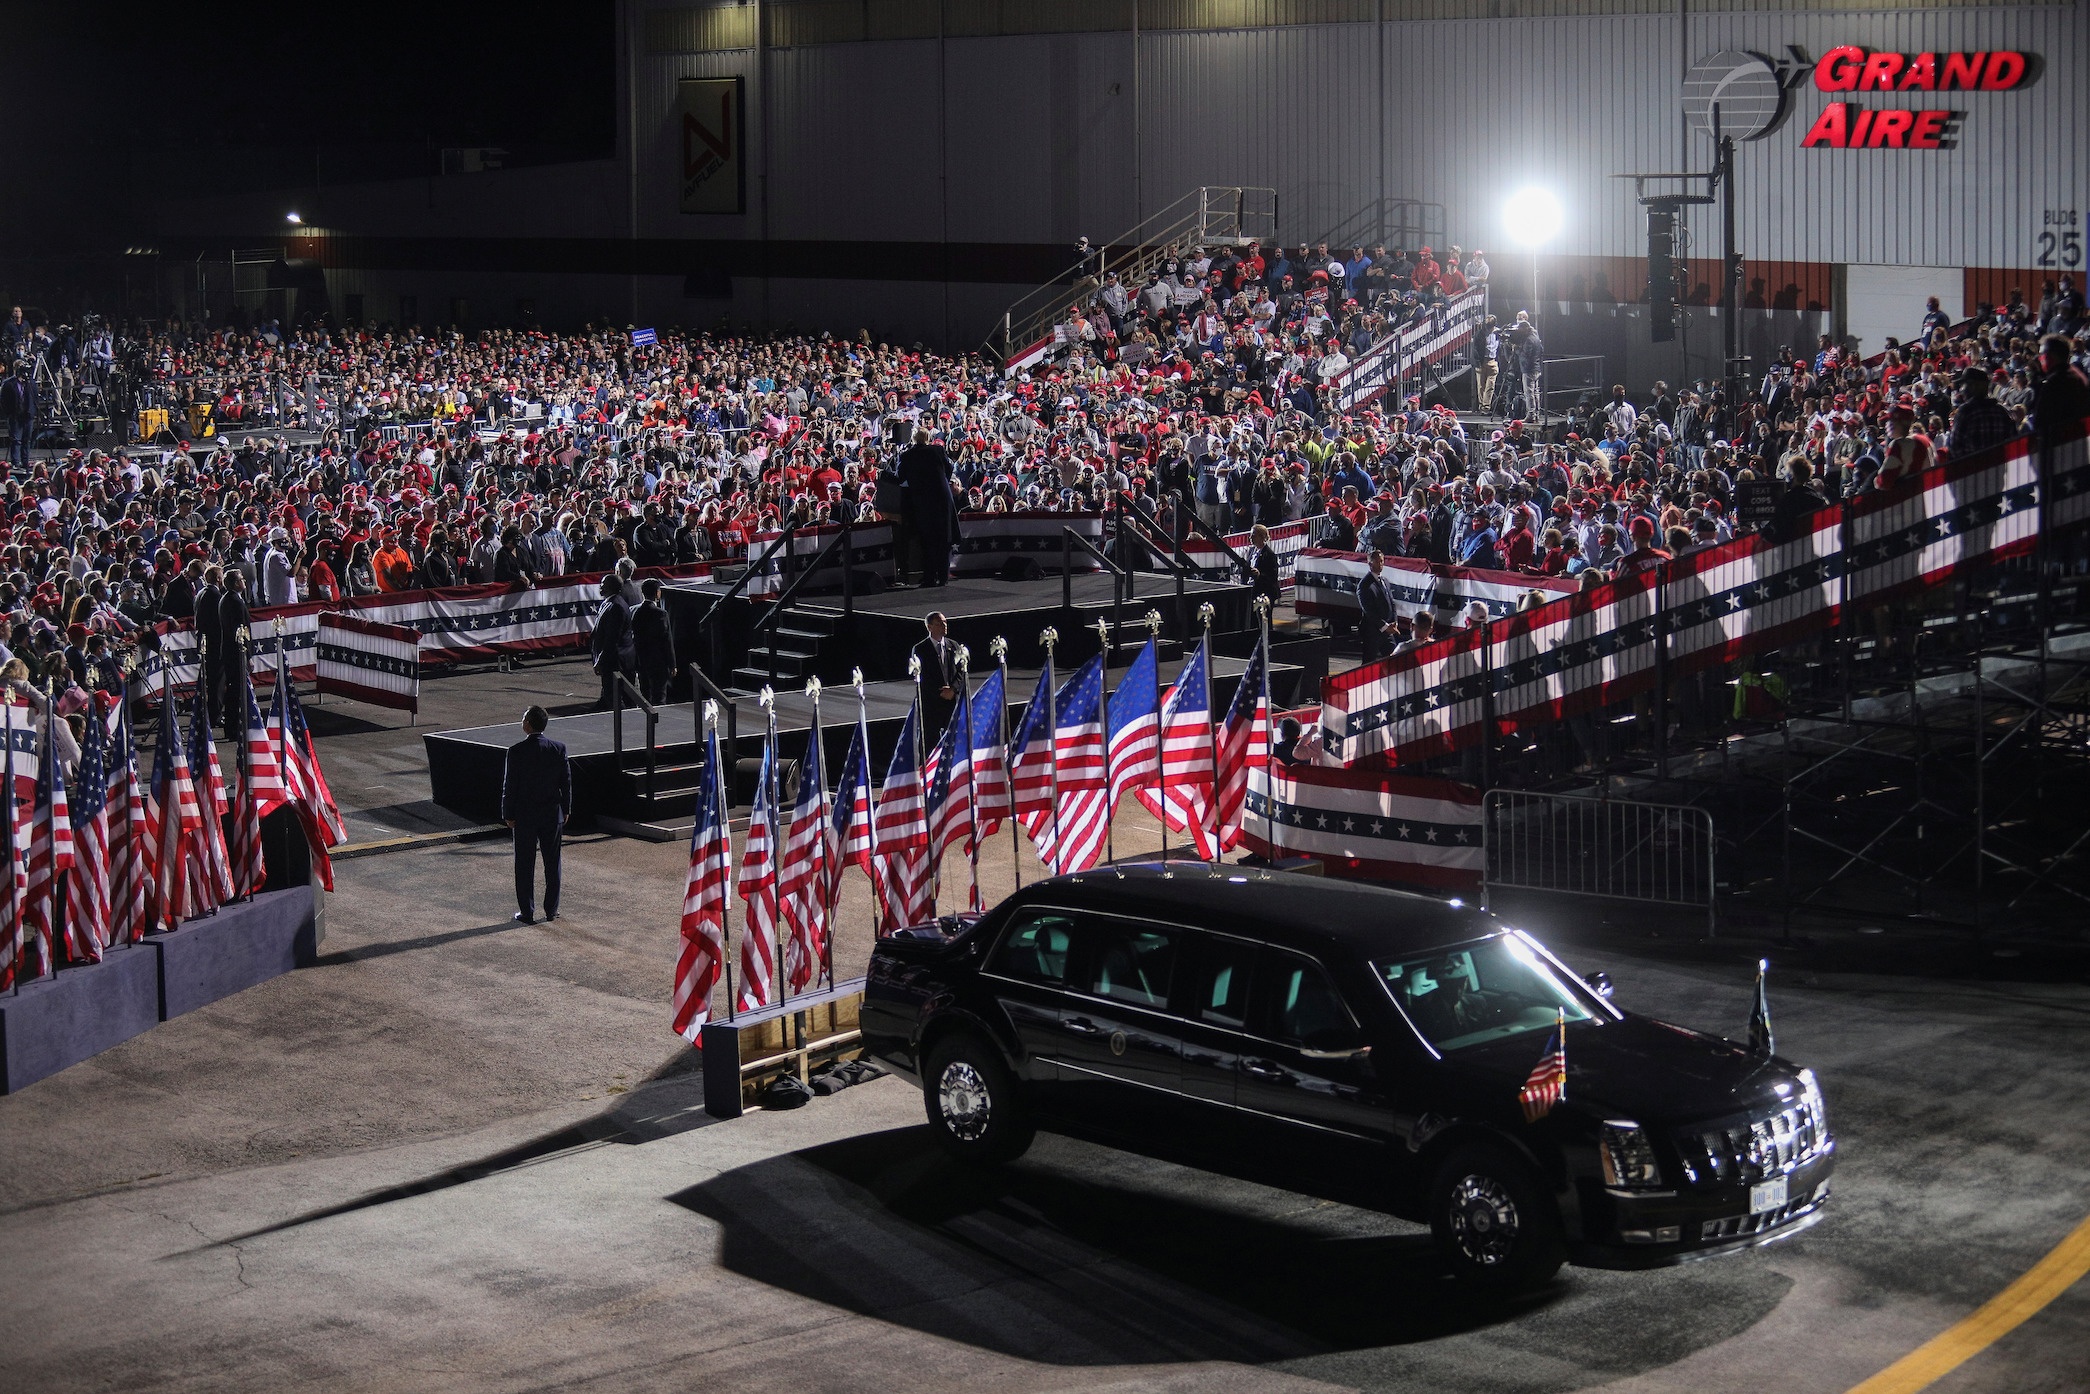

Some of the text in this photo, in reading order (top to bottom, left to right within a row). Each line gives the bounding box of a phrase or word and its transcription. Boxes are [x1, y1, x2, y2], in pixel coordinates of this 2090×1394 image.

[1814, 45, 2028, 92] GRAND
[1800, 102, 1953, 148] AIRE
[683, 157, 724, 201] AVFUEL
[2044, 210, 2077, 225] BLDG
[2037, 231, 2082, 267] 25
[1752, 487, 1771, 495] TEXT
